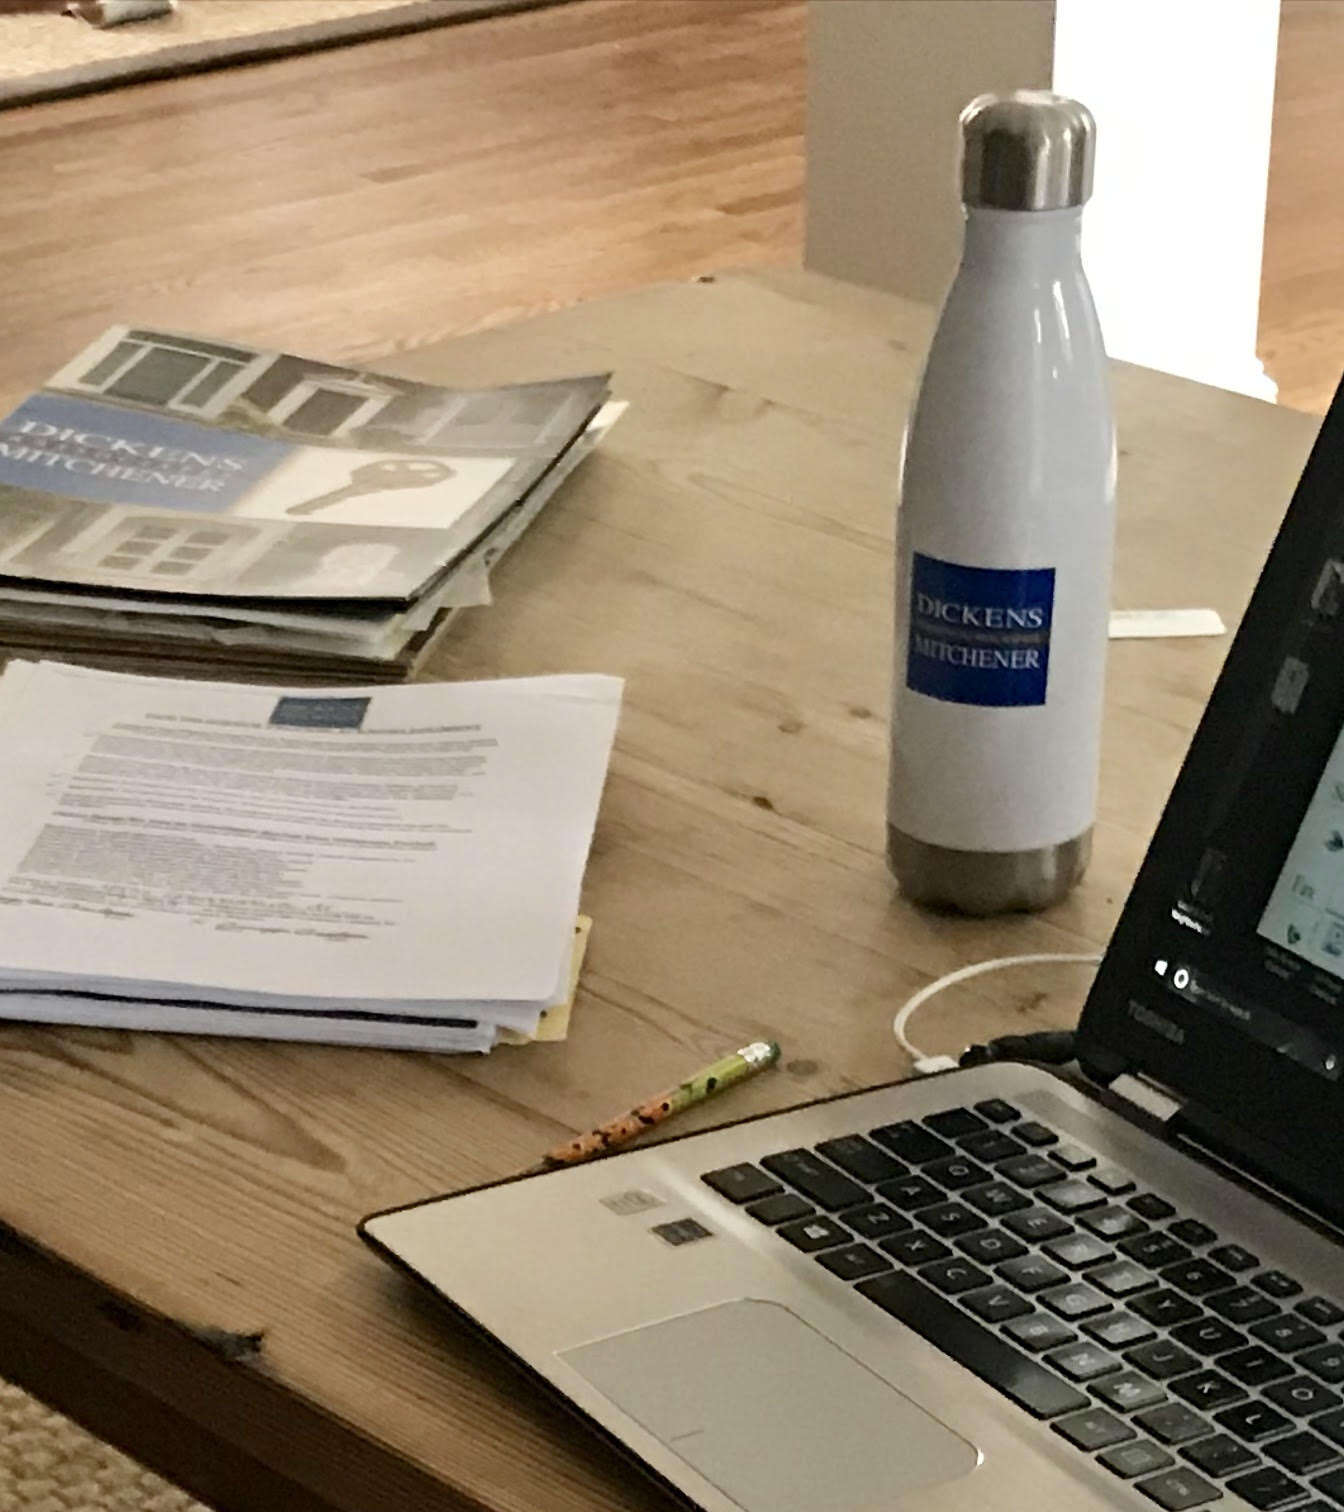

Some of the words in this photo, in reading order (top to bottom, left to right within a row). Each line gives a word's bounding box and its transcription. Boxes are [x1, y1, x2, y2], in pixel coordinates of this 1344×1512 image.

[20, 420, 247, 471] DICKENS
[917, 592, 1043, 629] DICKENS
[915, 633, 1040, 669] MITCHENER
